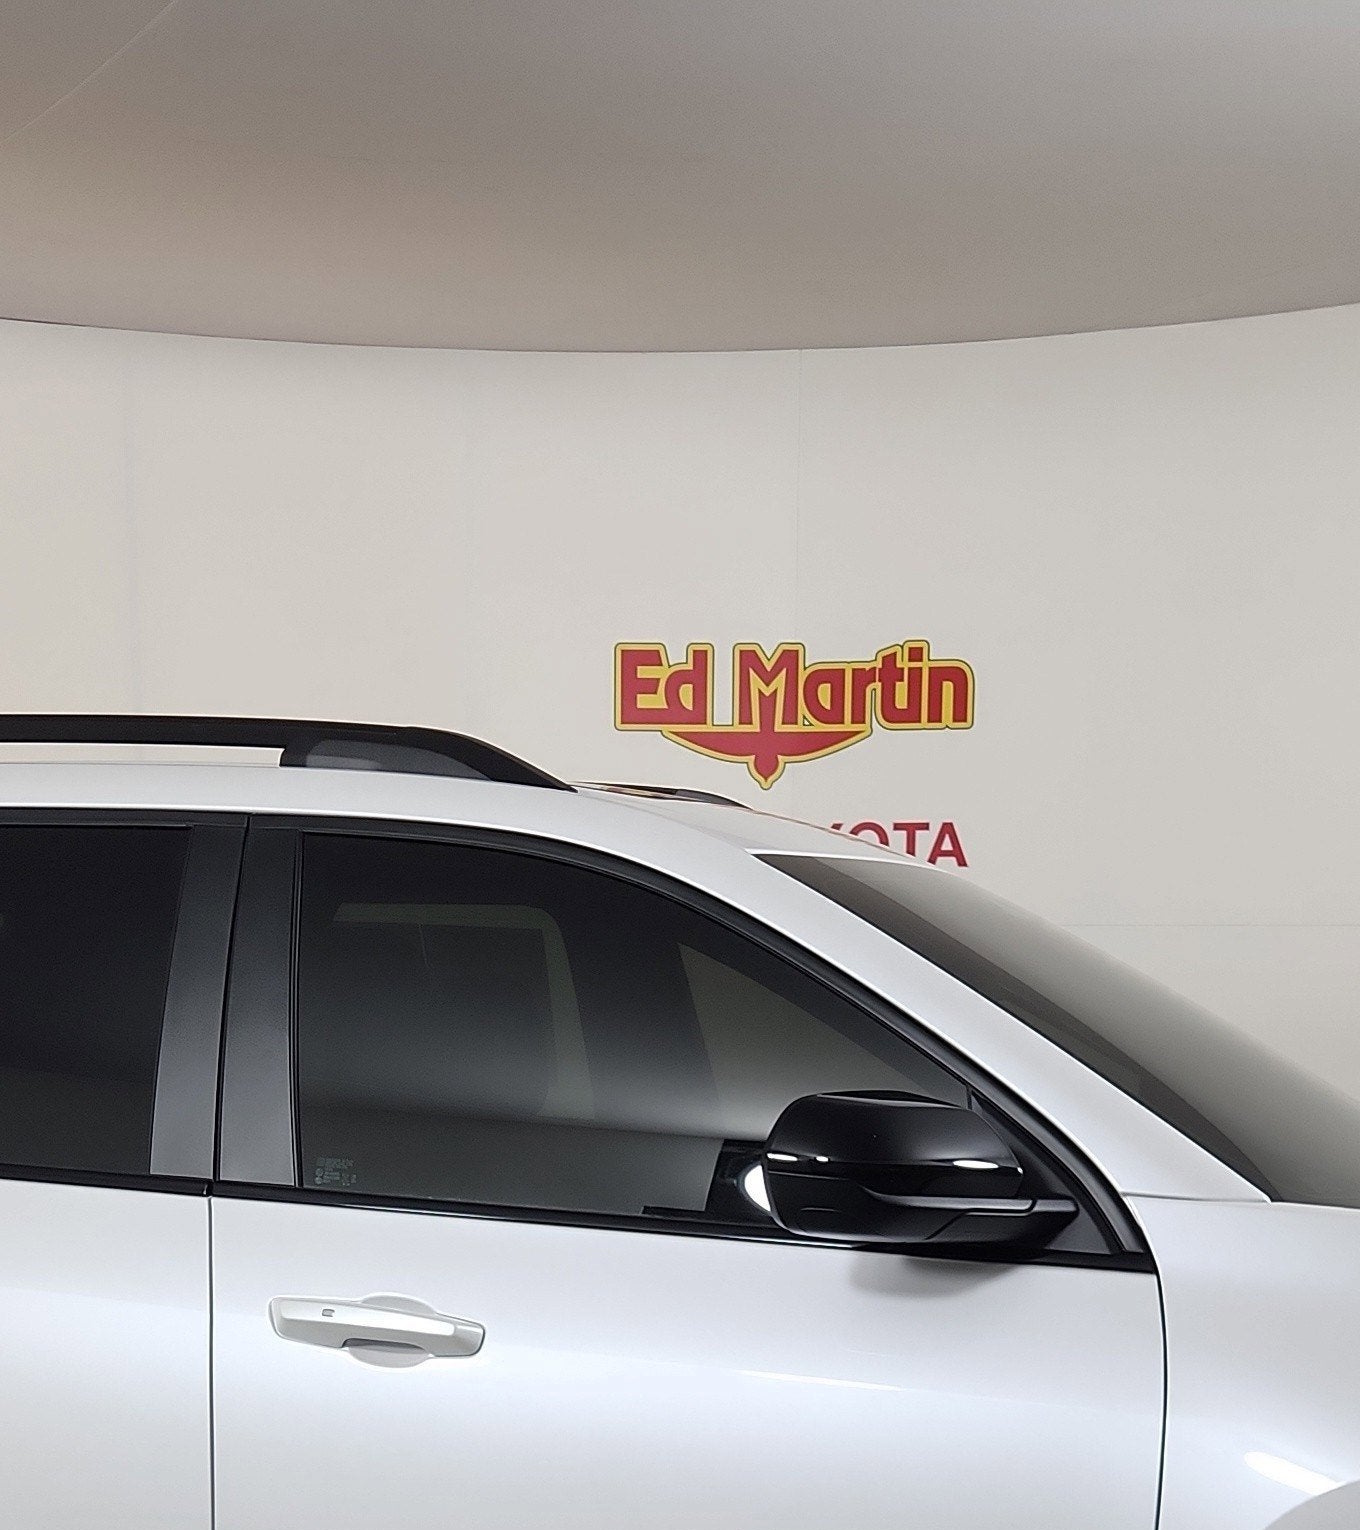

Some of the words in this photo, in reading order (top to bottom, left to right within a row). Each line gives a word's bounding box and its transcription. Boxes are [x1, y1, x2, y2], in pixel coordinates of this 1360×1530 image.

[615, 643, 713, 730] Ed
[734, 640, 974, 731] Martin
[831, 822, 968, 867] TA
